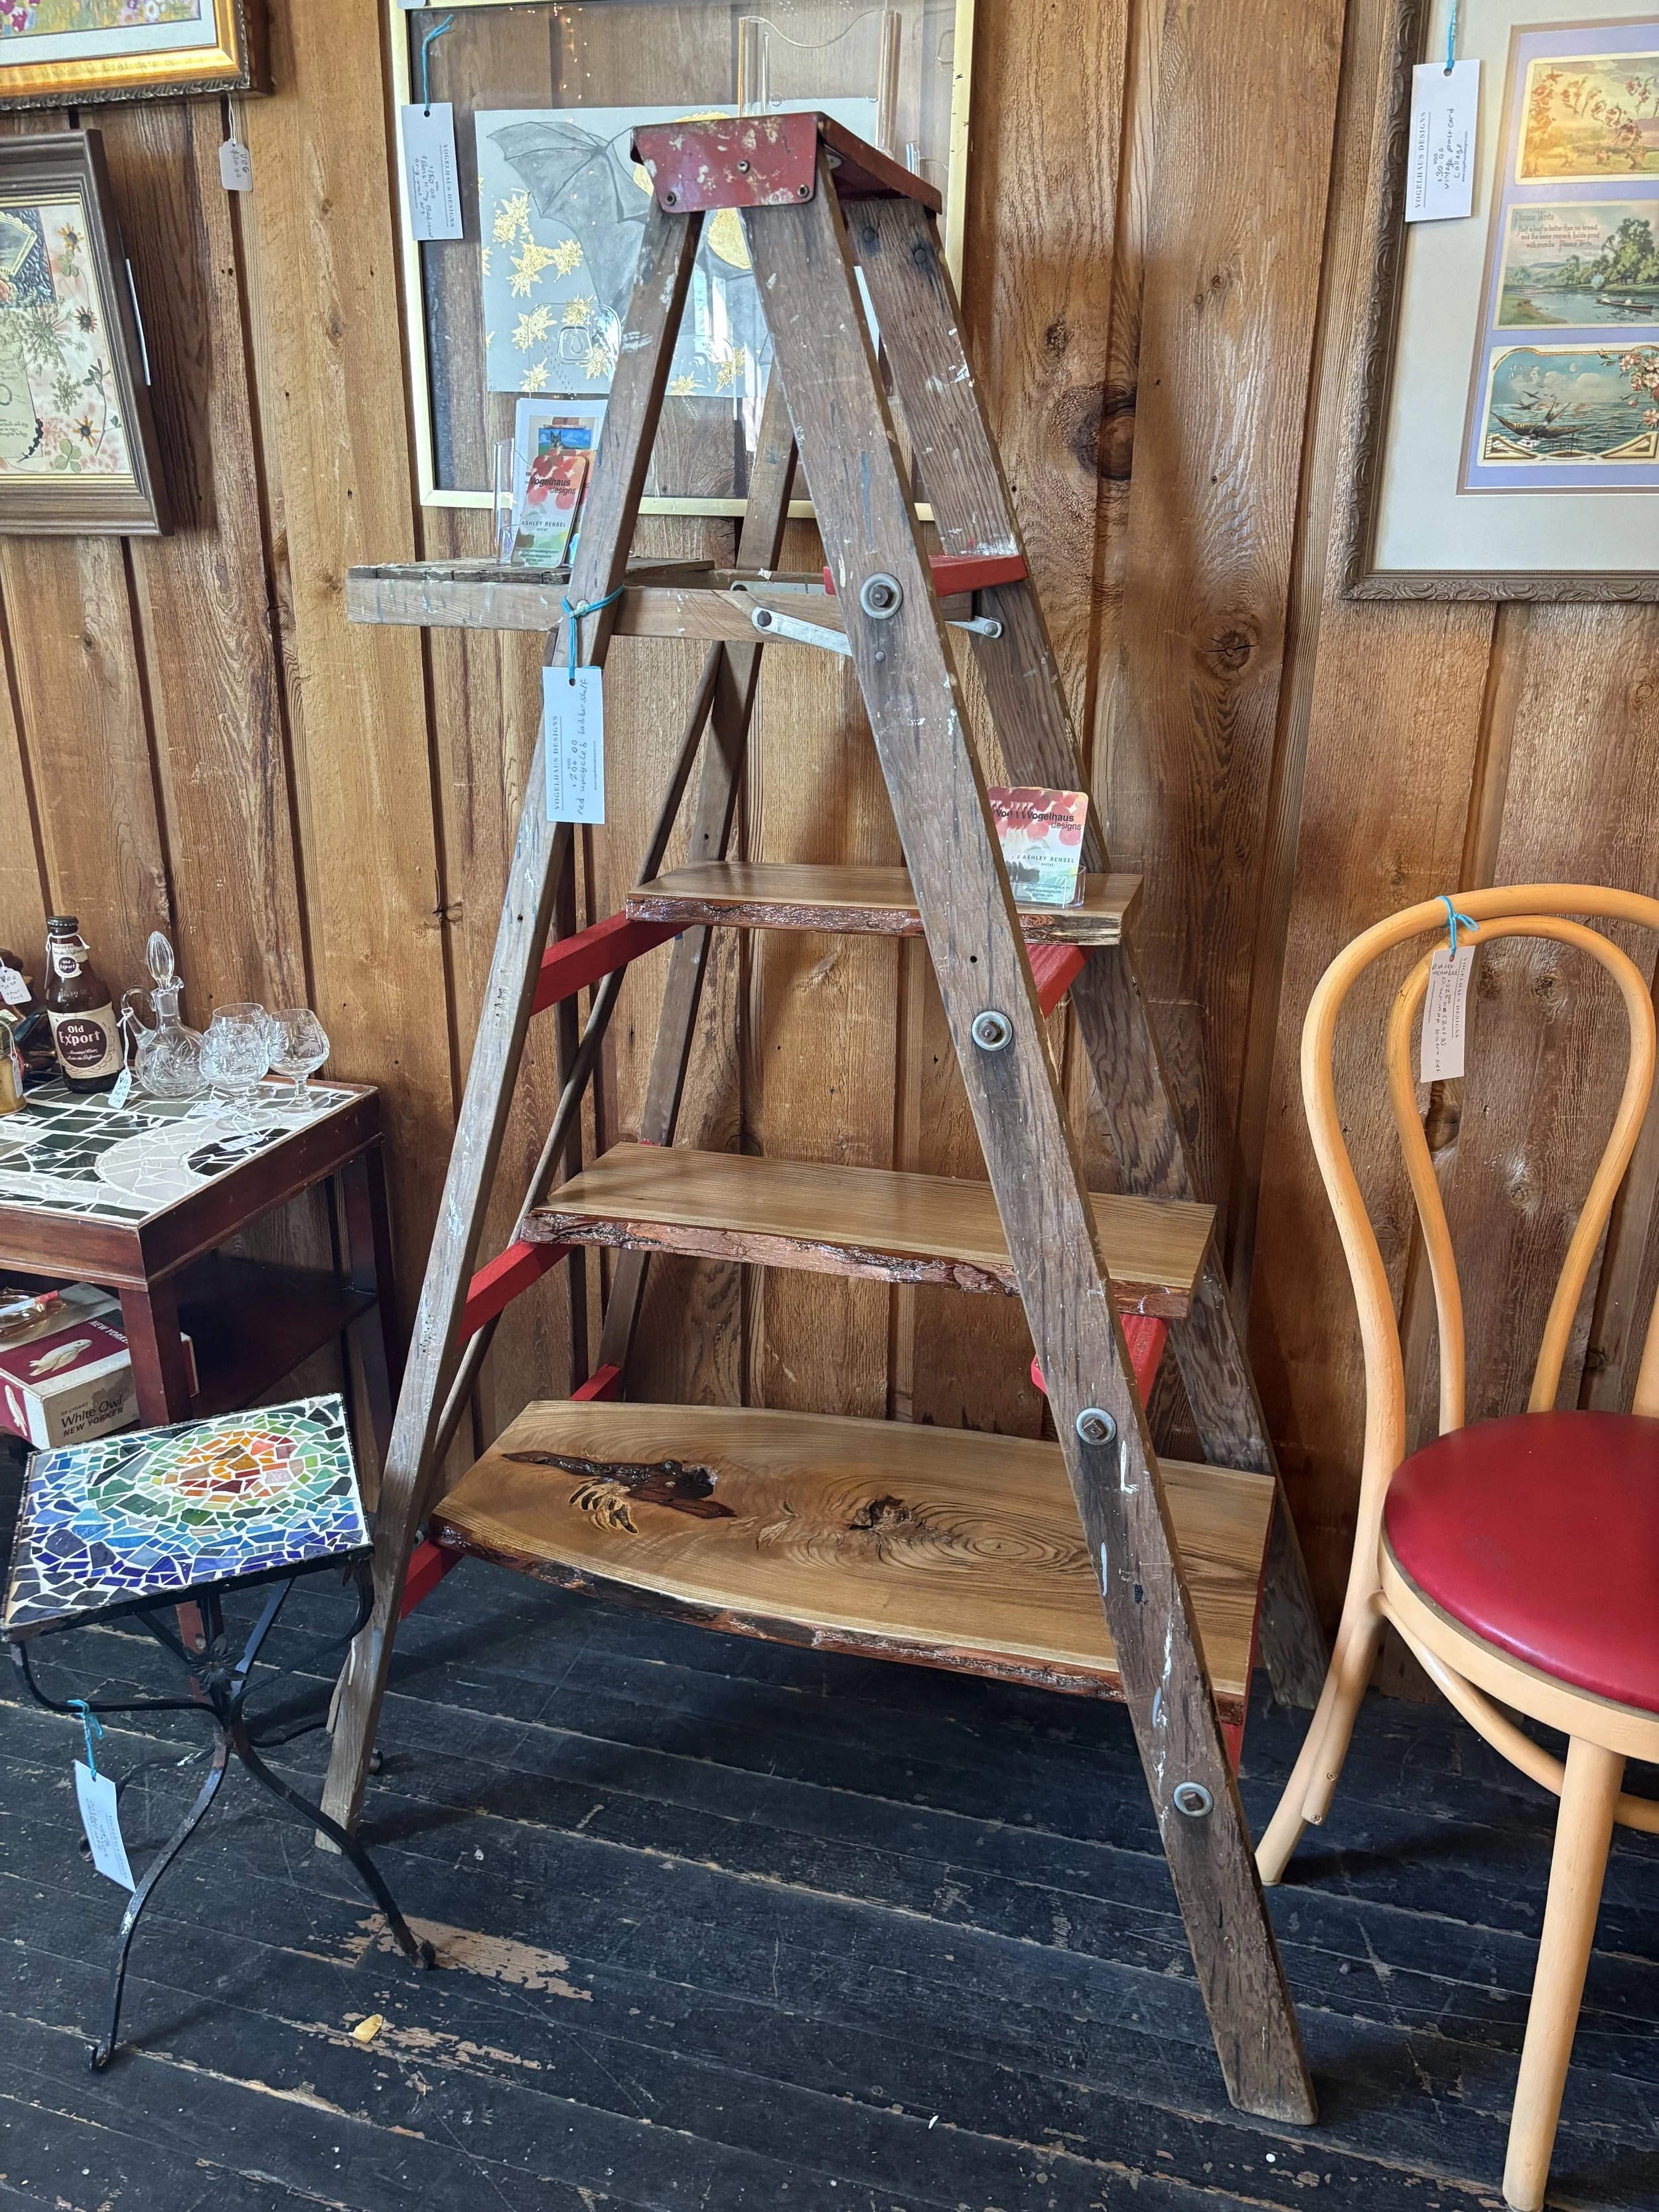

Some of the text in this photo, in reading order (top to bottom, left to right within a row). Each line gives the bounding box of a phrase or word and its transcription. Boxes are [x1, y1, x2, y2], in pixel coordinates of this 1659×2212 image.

[240, 154, 249, 173] VOG
[1415, 154, 1424, 208] VOGELHAUS
[530, 478, 571, 487] Vogelhaus
[550, 486, 576, 495] designs
[1027, 811, 1074, 822] Vogelhaus
[1051, 820, 1082, 832] designs
[58, 1031, 100, 1046] Export
[88, 1321, 110, 1330] NEW
[61, 1396, 122, 1428] White Owl
[68, 1402, 89, 1412] CIGARS
[64, 1407, 123, 1438] NEW YORKER
